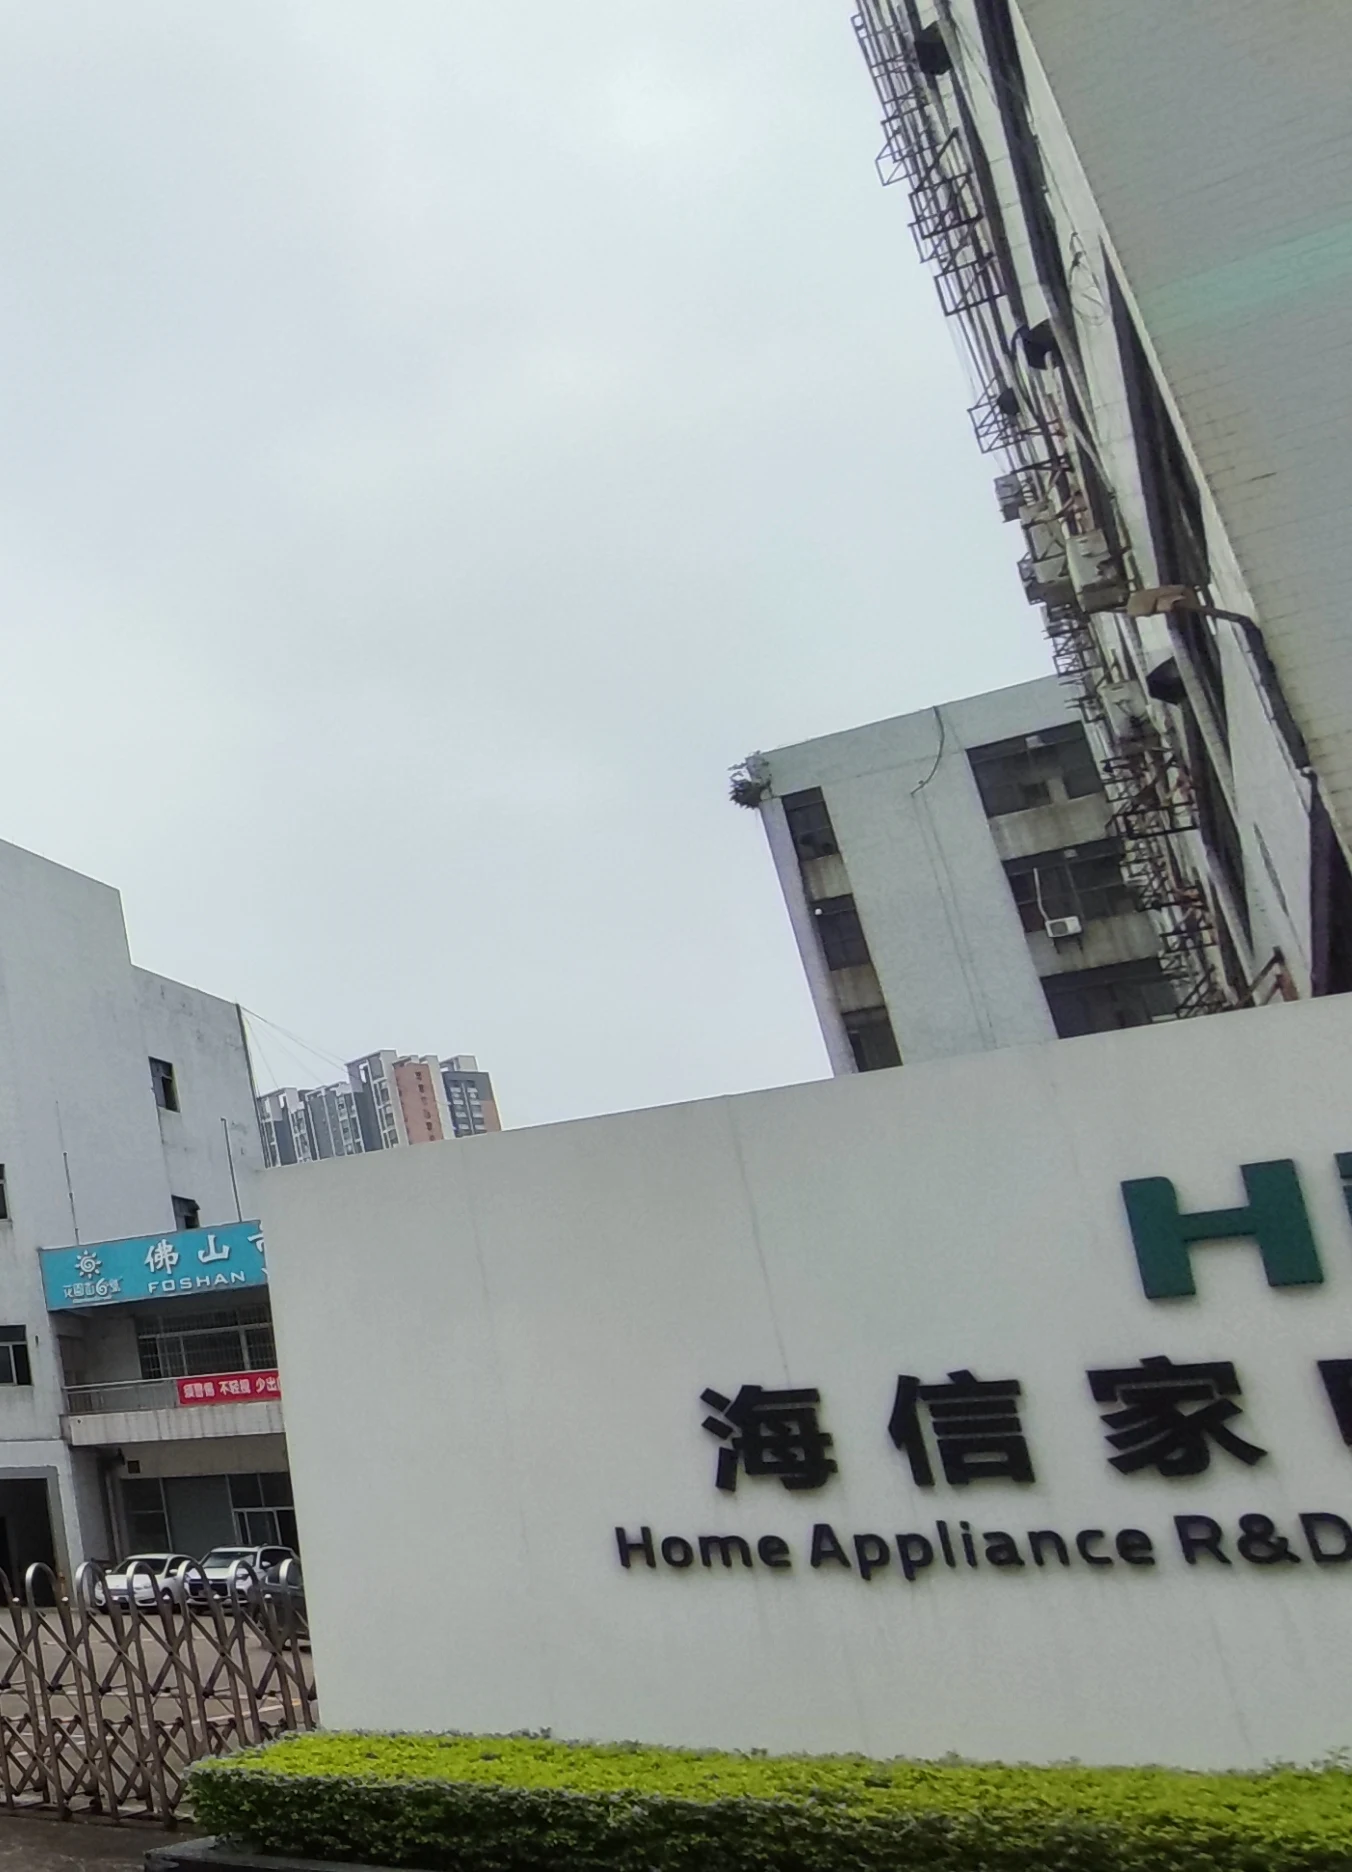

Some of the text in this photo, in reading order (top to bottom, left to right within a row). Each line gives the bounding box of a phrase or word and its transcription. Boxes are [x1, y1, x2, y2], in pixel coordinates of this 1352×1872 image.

[148, 1270, 246, 1294] FOSHAN
[615, 1511, 1352, 1582] Home Appliance R&D
